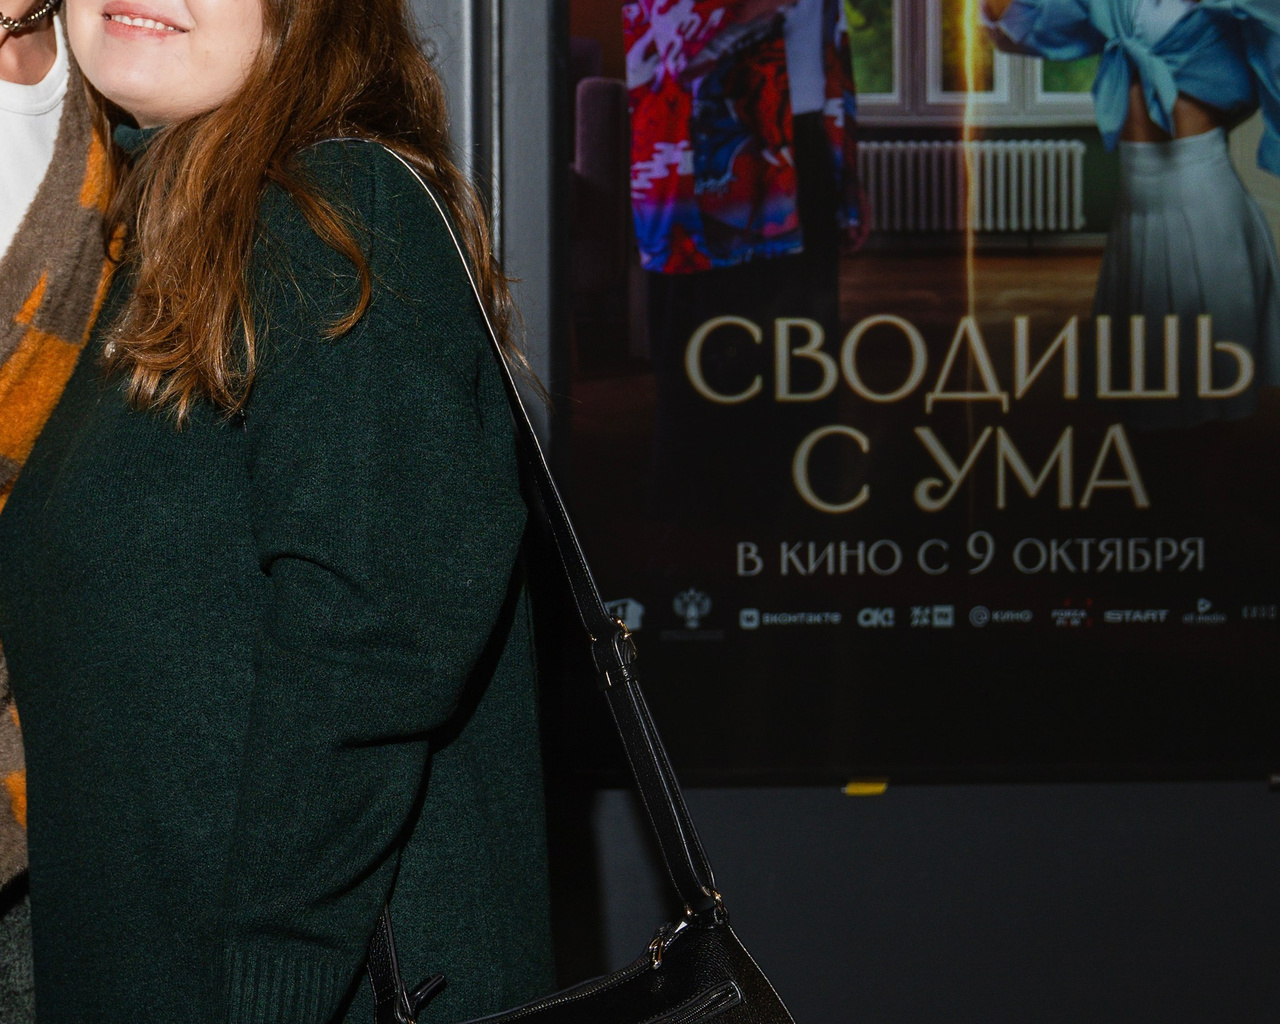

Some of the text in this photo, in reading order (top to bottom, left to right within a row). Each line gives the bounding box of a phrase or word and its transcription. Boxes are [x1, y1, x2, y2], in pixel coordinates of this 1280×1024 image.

[685, 314, 1254, 414] СВОДИШЬ
[792, 423, 1149, 514] С УМА
[737, 530, 1204, 576] В КИНО С 9 ОКТЯБРЯ
[1104, 609, 1168, 622] START
